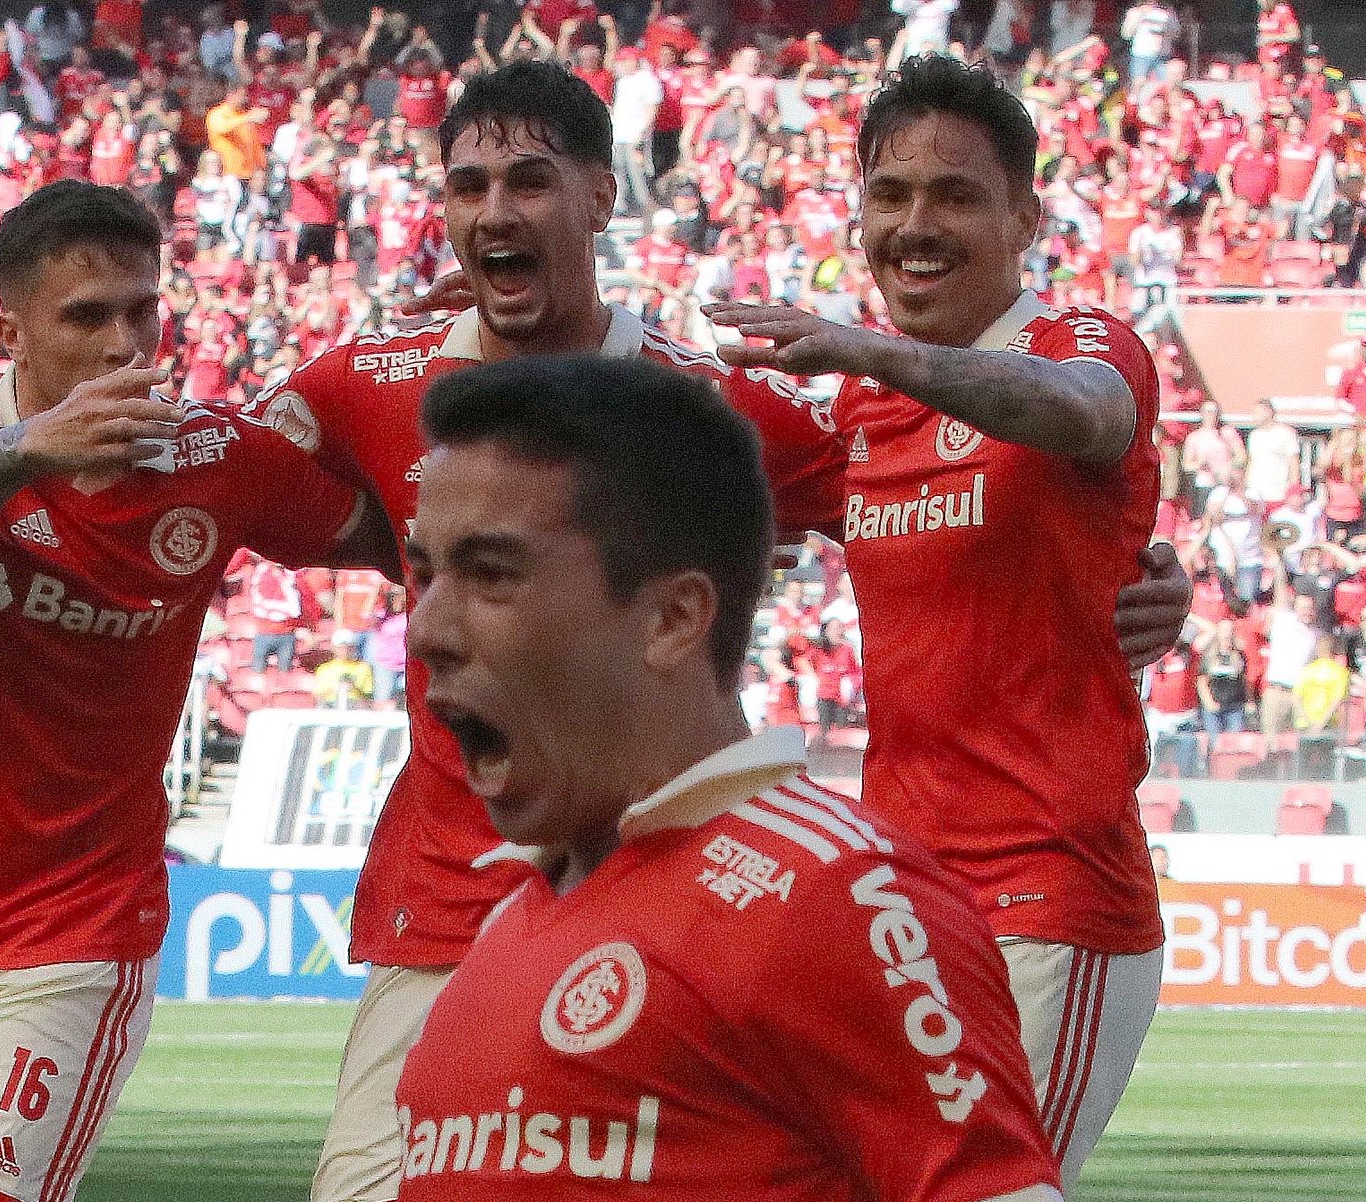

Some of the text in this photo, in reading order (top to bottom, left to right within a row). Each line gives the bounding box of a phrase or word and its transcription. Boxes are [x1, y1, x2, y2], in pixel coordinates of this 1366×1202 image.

[353, 346, 441, 371] ESTRELA
[389, 361, 429, 383] BET
[190, 442, 228, 466] BET
[845, 473, 985, 543] Banrisul
[702, 833, 796, 902] ESTRELA
[187, 870, 372, 1000] pix
[850, 864, 963, 1057] vero
[398, 1086, 661, 1184] anrisul
